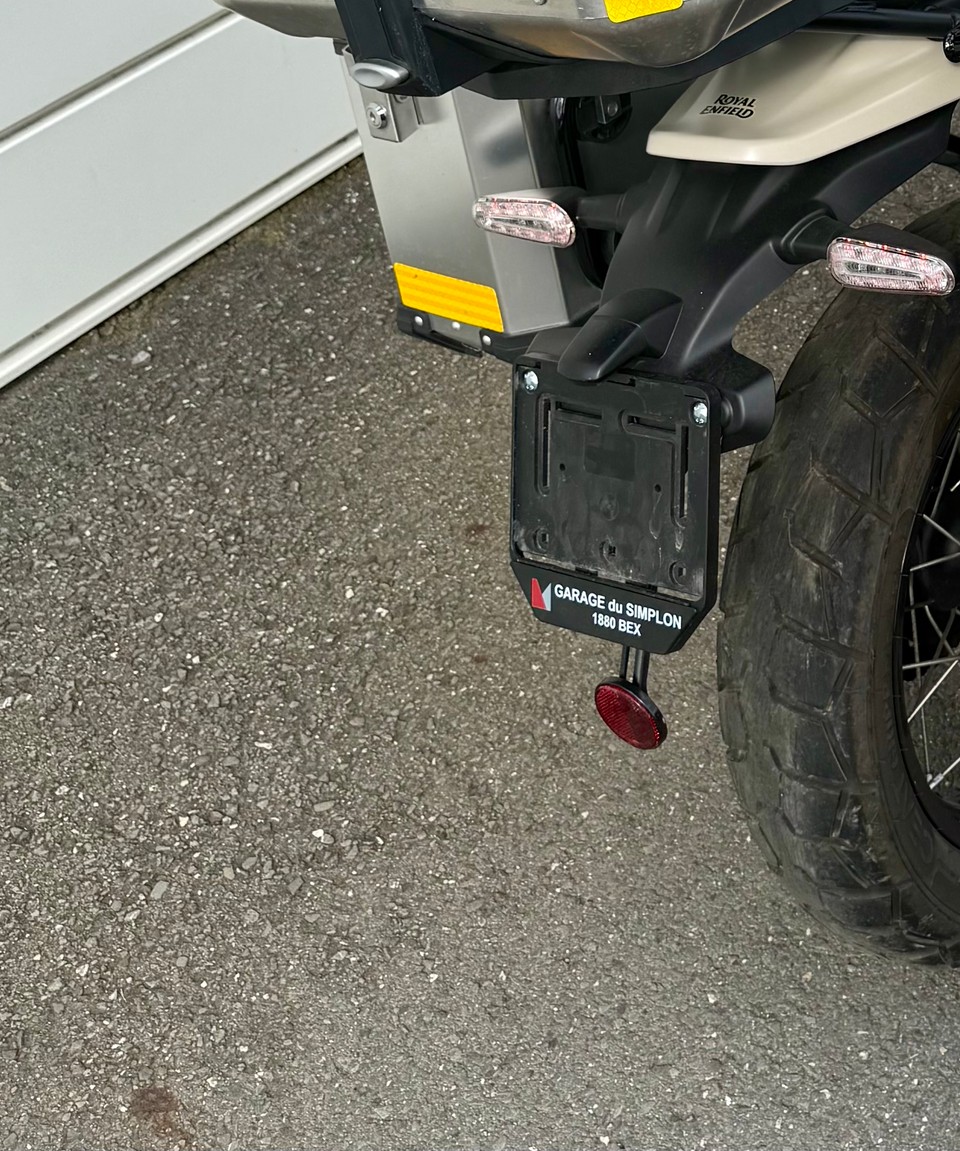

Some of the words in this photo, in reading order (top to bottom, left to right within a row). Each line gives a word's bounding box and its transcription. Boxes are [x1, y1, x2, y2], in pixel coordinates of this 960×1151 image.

[714, 94, 756, 107] ROYAL
[699, 105, 754, 119] ENFIELD
[554, 584, 606, 609] GARAGE
[608, 599, 623, 614] du
[626, 602, 682, 630] SIMPLON
[592, 612, 616, 630] 1880
[618, 619, 642, 636] BEX
